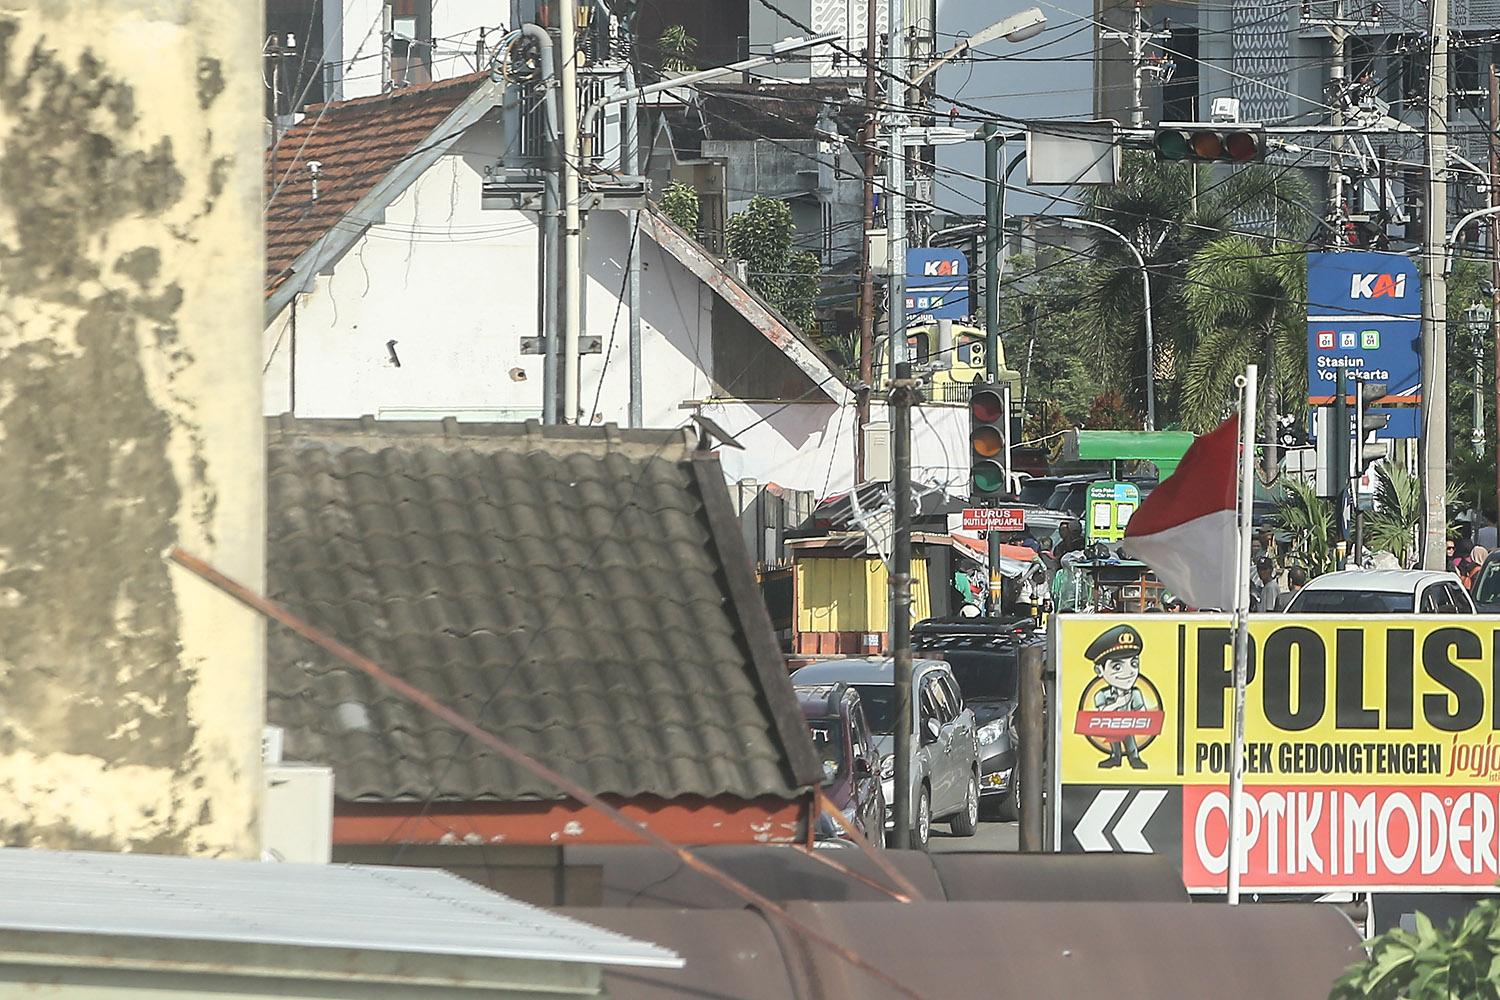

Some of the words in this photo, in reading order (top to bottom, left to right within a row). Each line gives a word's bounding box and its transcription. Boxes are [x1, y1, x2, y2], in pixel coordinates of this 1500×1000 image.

[924, 260, 959, 276] KAI
[1350, 273, 1406, 299] KAI
[1317, 355, 1364, 367] Stasiun
[974, 510, 1011, 518] LURUS
[963, 518, 980, 526] IKUTI
[981, 518, 1003, 526] LAMPU
[1004, 518, 1023, 526] APILL
[1088, 716, 1151, 730] PRESISI
[1278, 742, 1441, 774] GEDONGTENGEN
